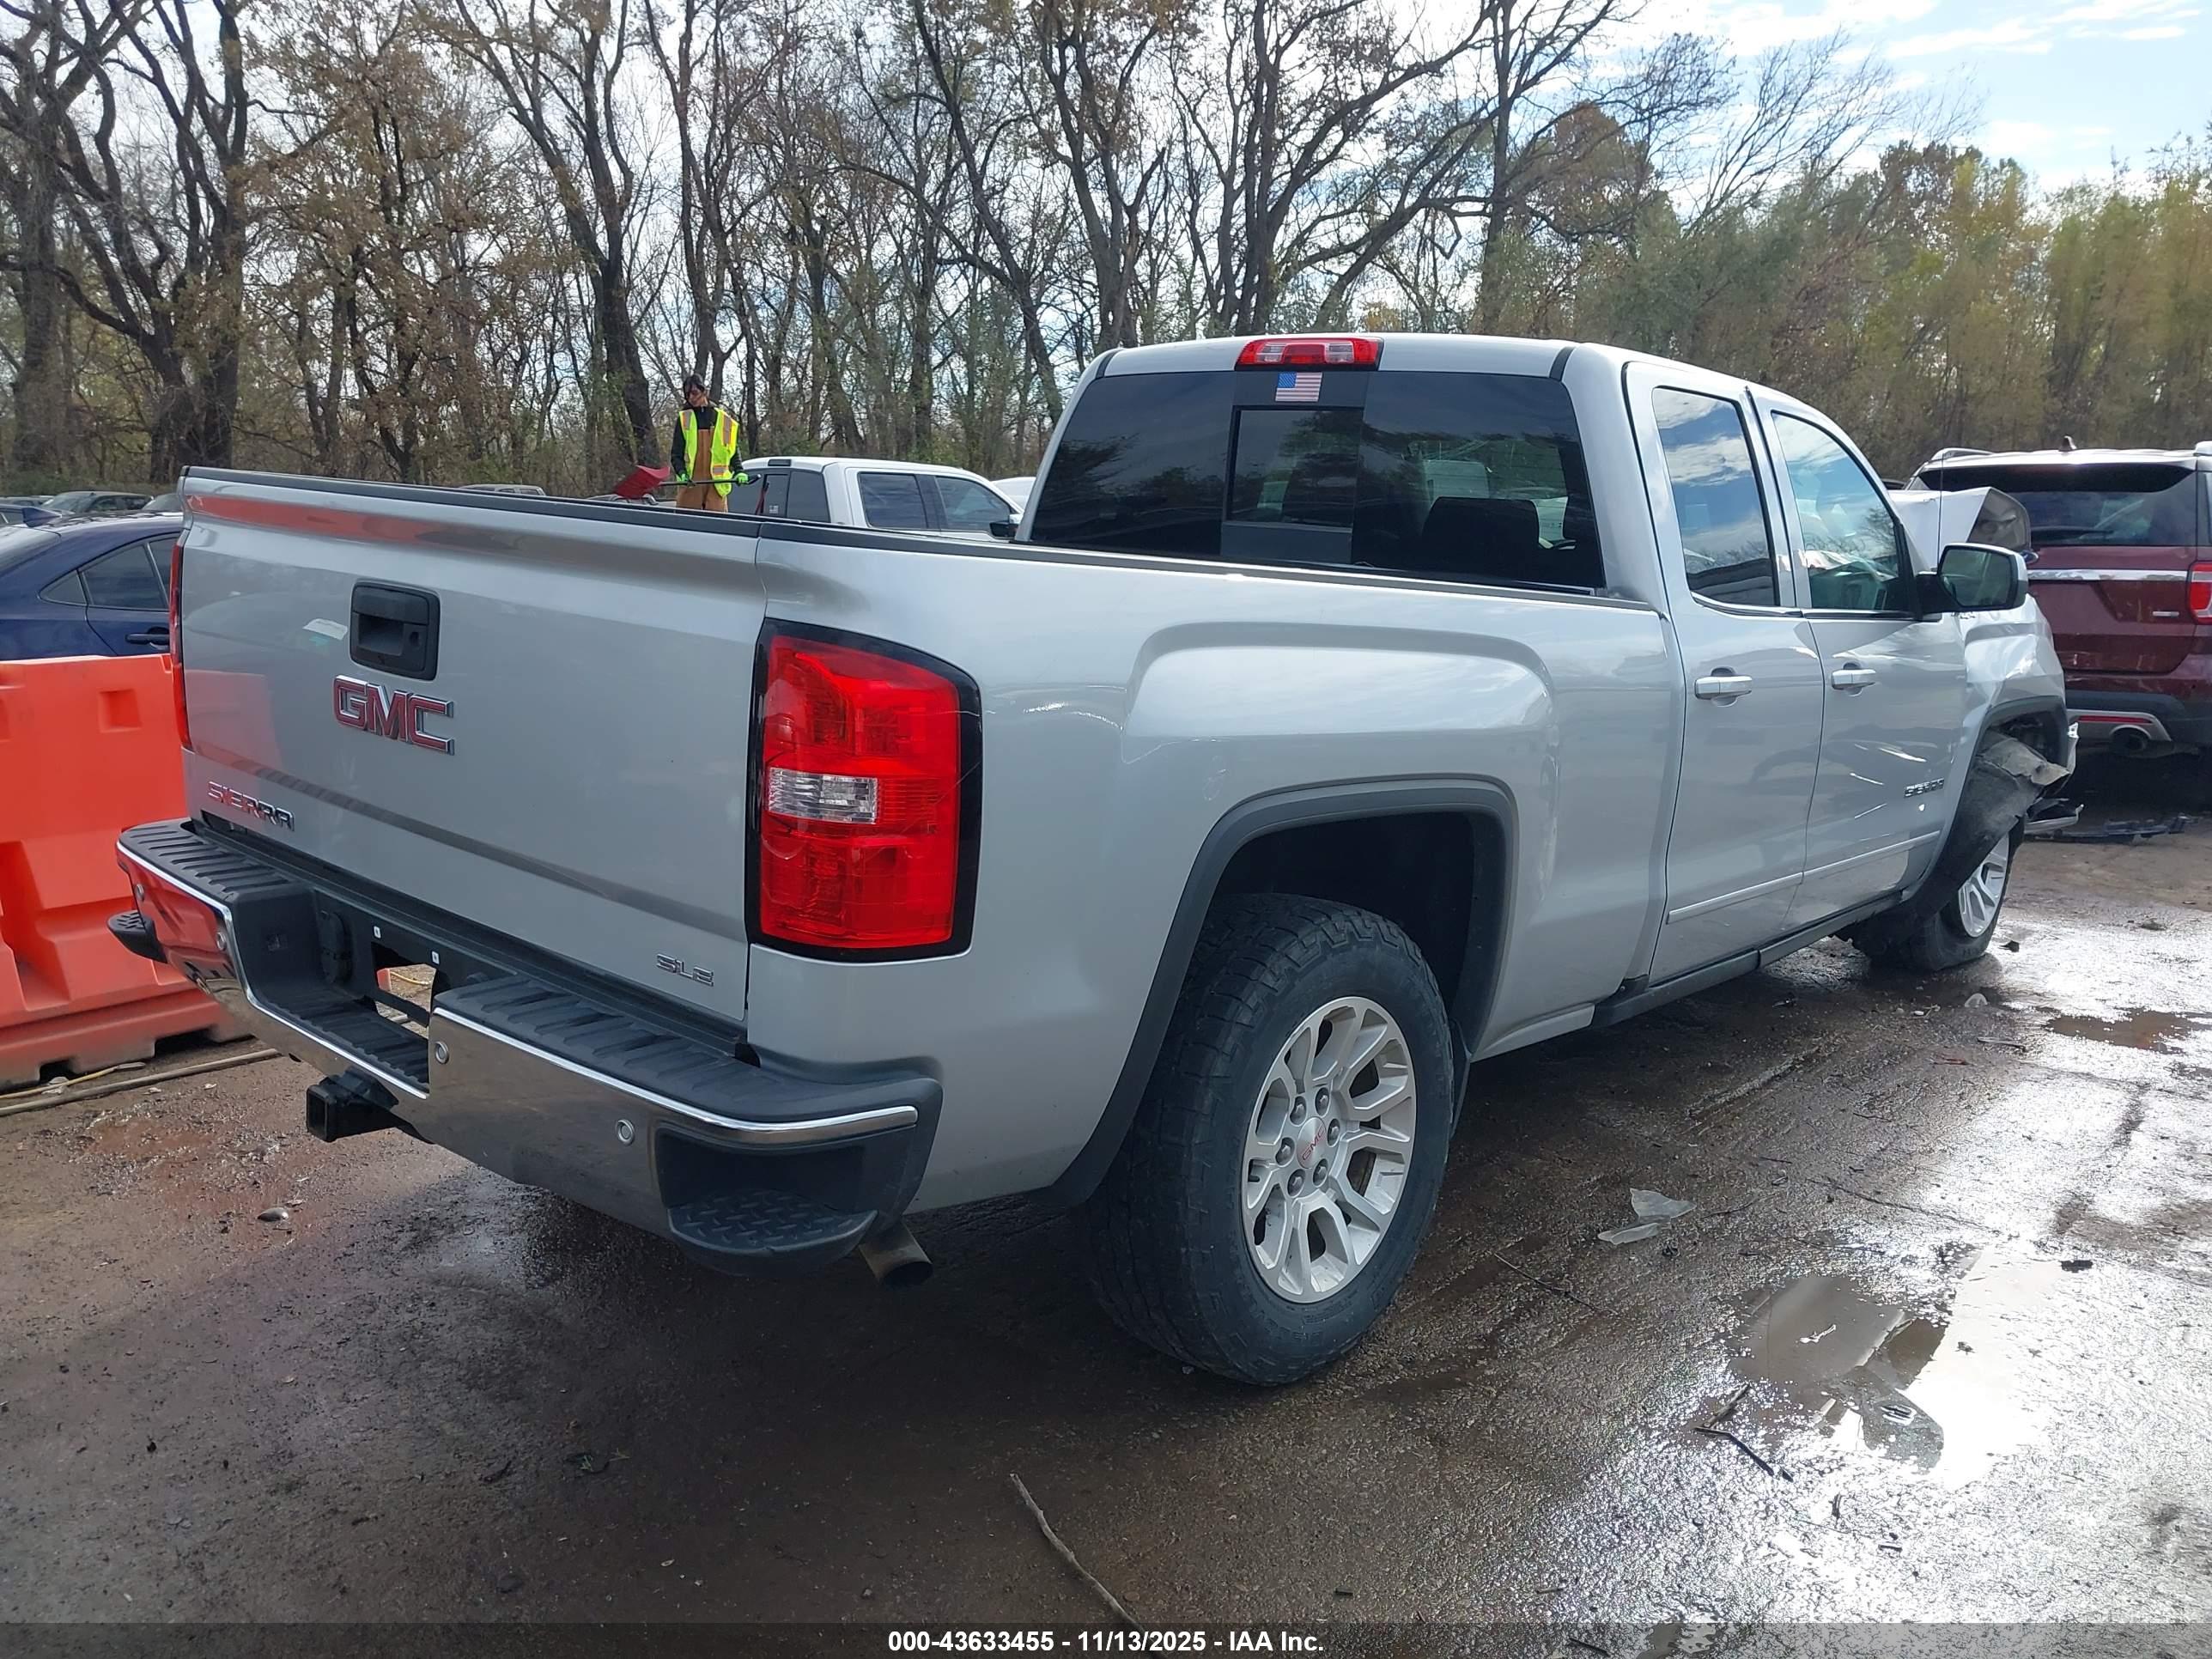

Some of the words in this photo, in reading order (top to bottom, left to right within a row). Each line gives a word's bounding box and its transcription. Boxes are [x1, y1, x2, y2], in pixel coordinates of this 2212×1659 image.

[333, 675, 455, 756] GMC
[207, 780, 295, 831] SIERRA
[655, 952, 714, 988] SLE
[1301, 1122, 1326, 1161] GMC
